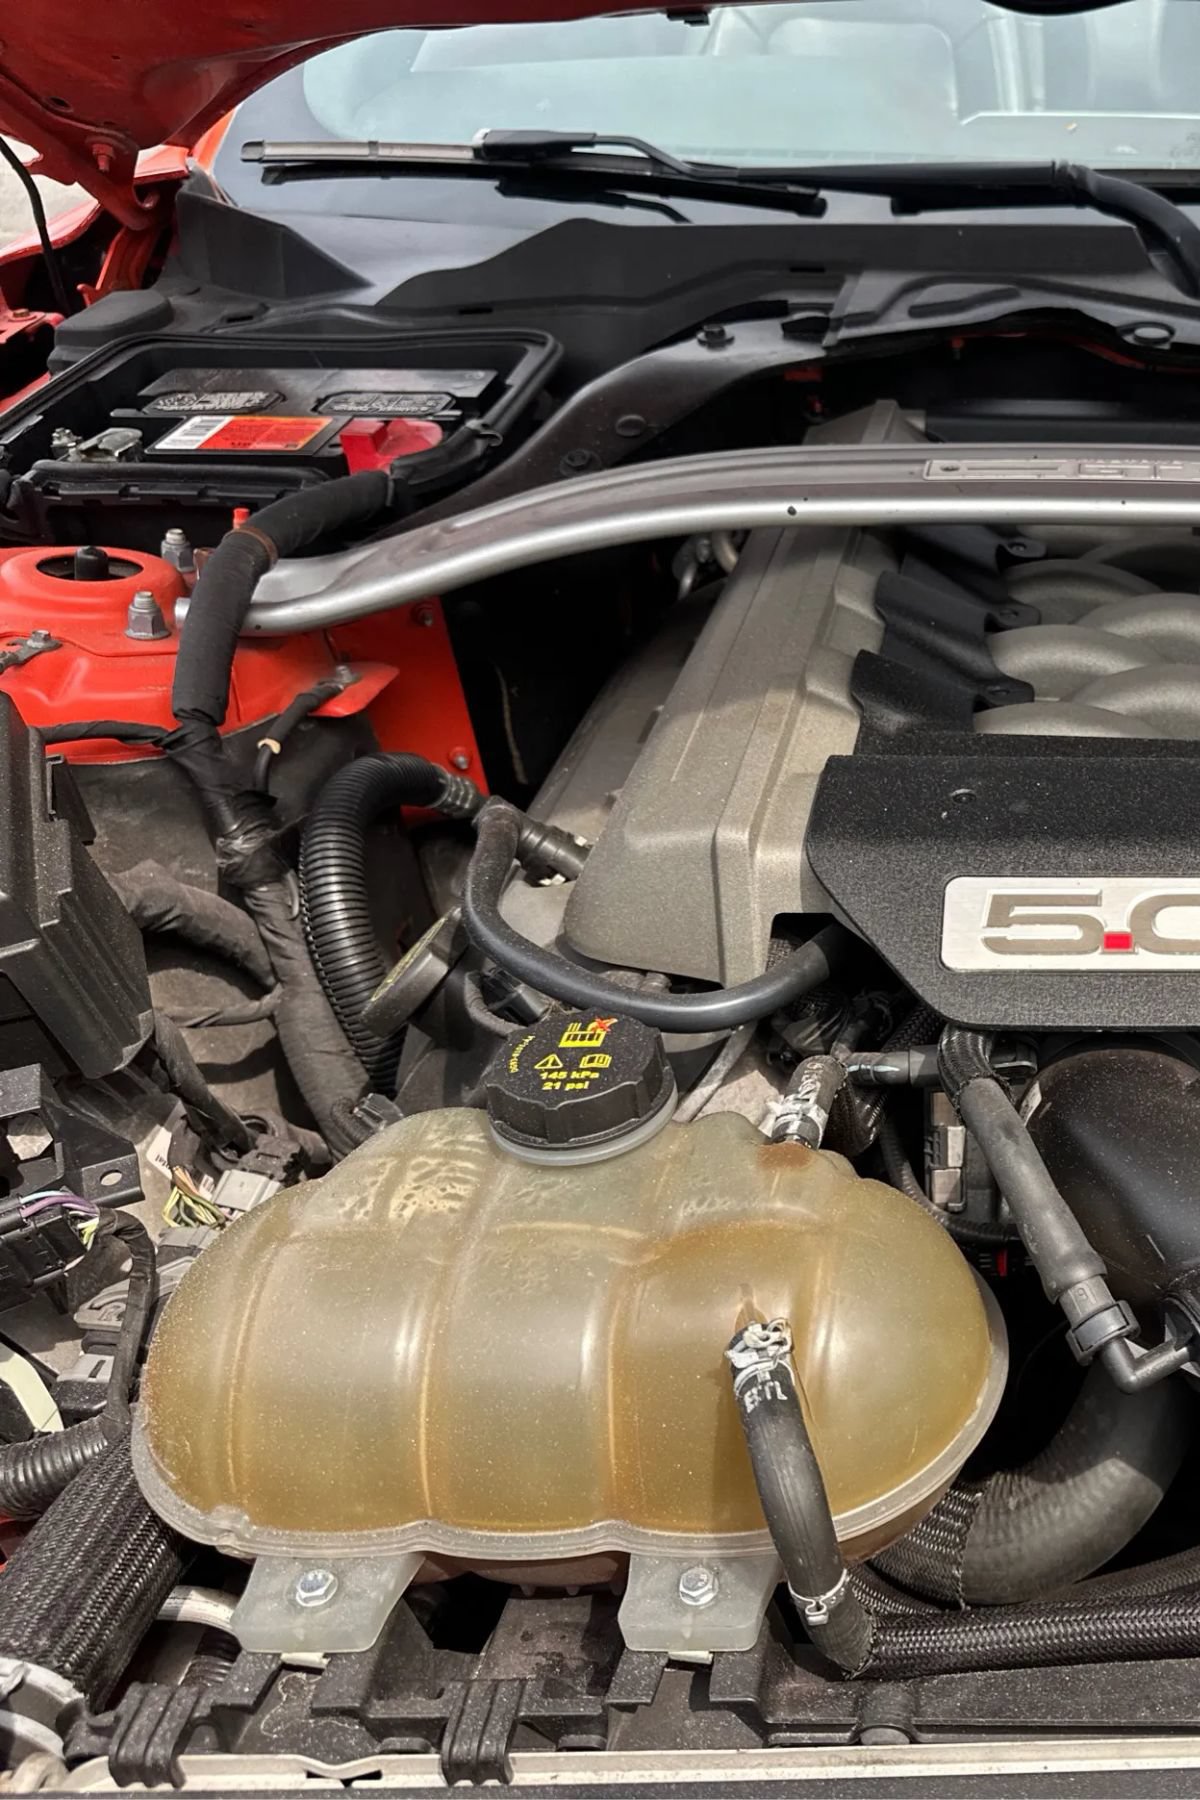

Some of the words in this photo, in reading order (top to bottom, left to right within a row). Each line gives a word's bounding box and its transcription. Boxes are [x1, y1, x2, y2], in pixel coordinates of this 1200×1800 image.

[540, 1071, 568, 1080] 145
[570, 1070, 600, 1079] kPa
[541, 1081, 561, 1090] 21
[564, 1080, 590, 1091] psi
